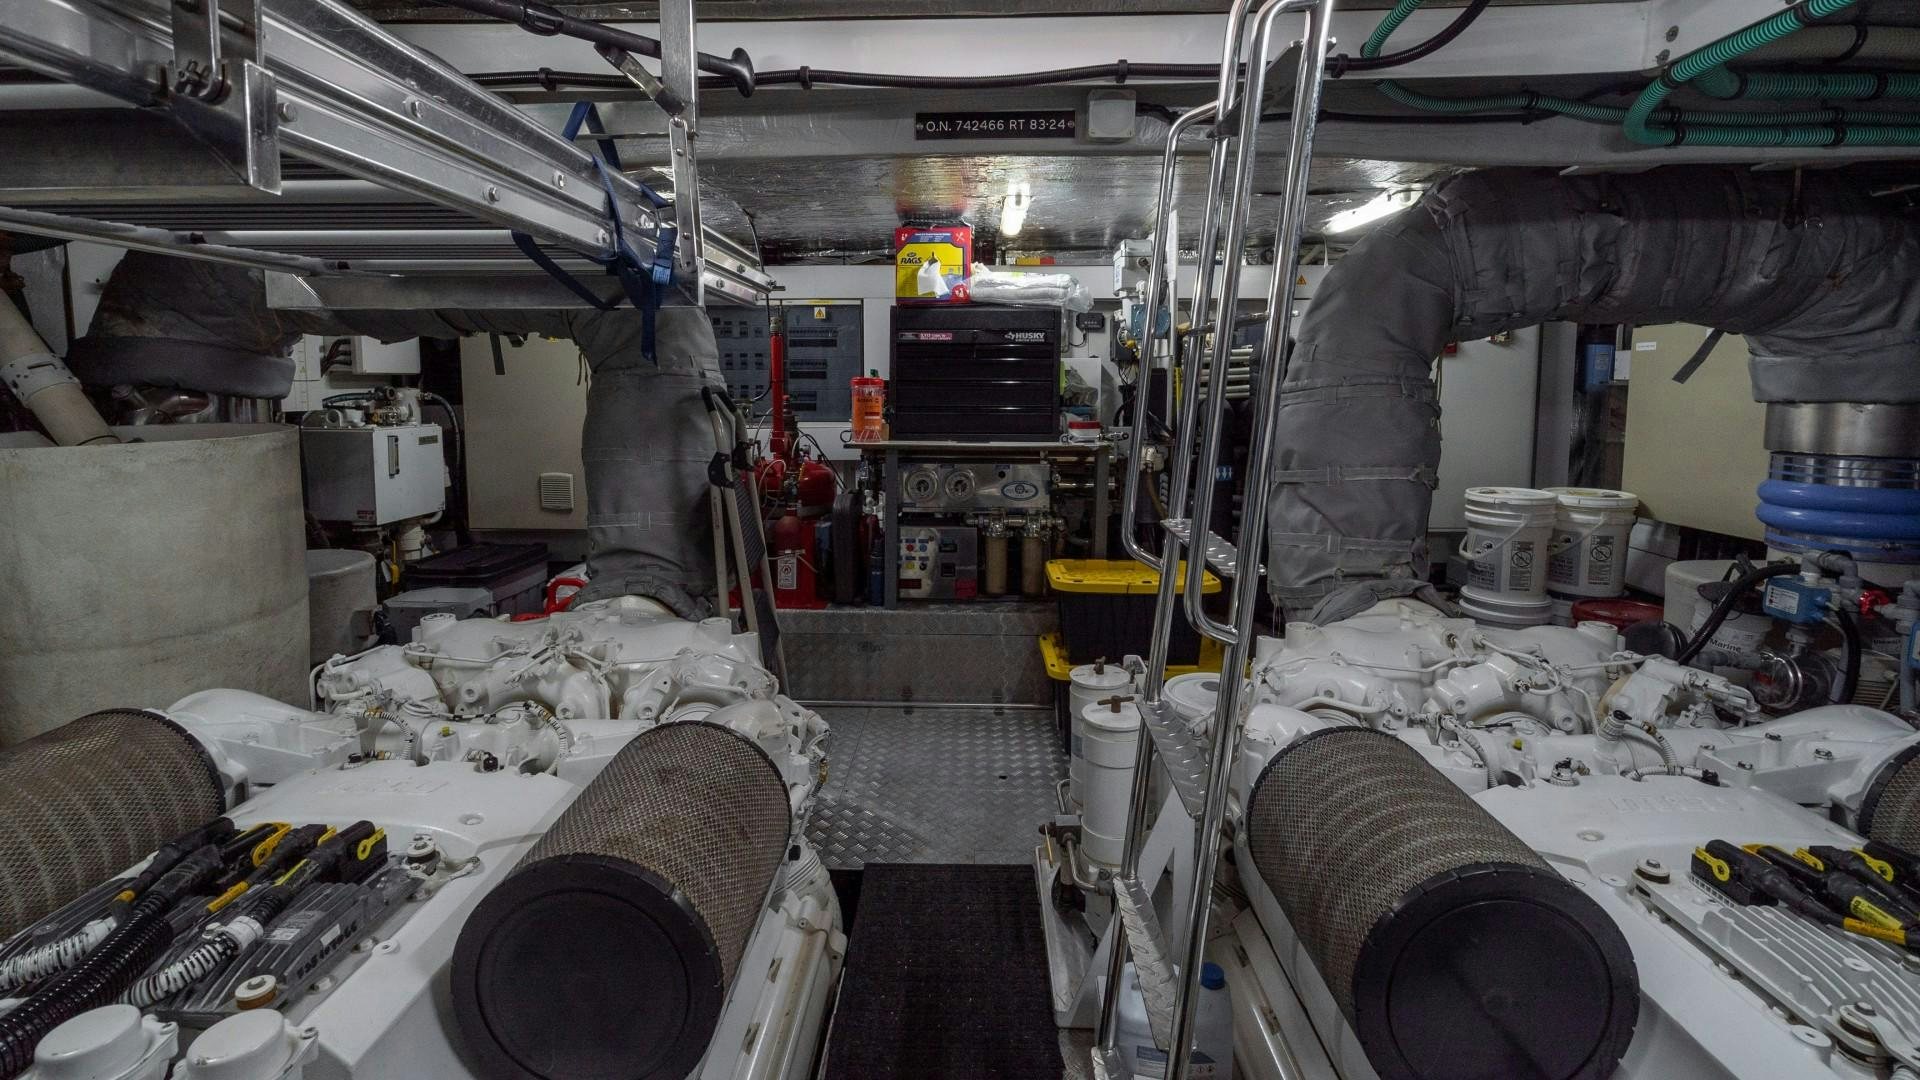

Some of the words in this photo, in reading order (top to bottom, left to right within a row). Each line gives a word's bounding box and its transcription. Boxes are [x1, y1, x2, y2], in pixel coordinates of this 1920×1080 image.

[925, 120, 952, 132] O.N.
[955, 119, 1005, 131] 742466
[1009, 119, 1025, 130] RT
[900, 257, 922, 265] RAGS
[1709, 637, 1742, 652] Marine
